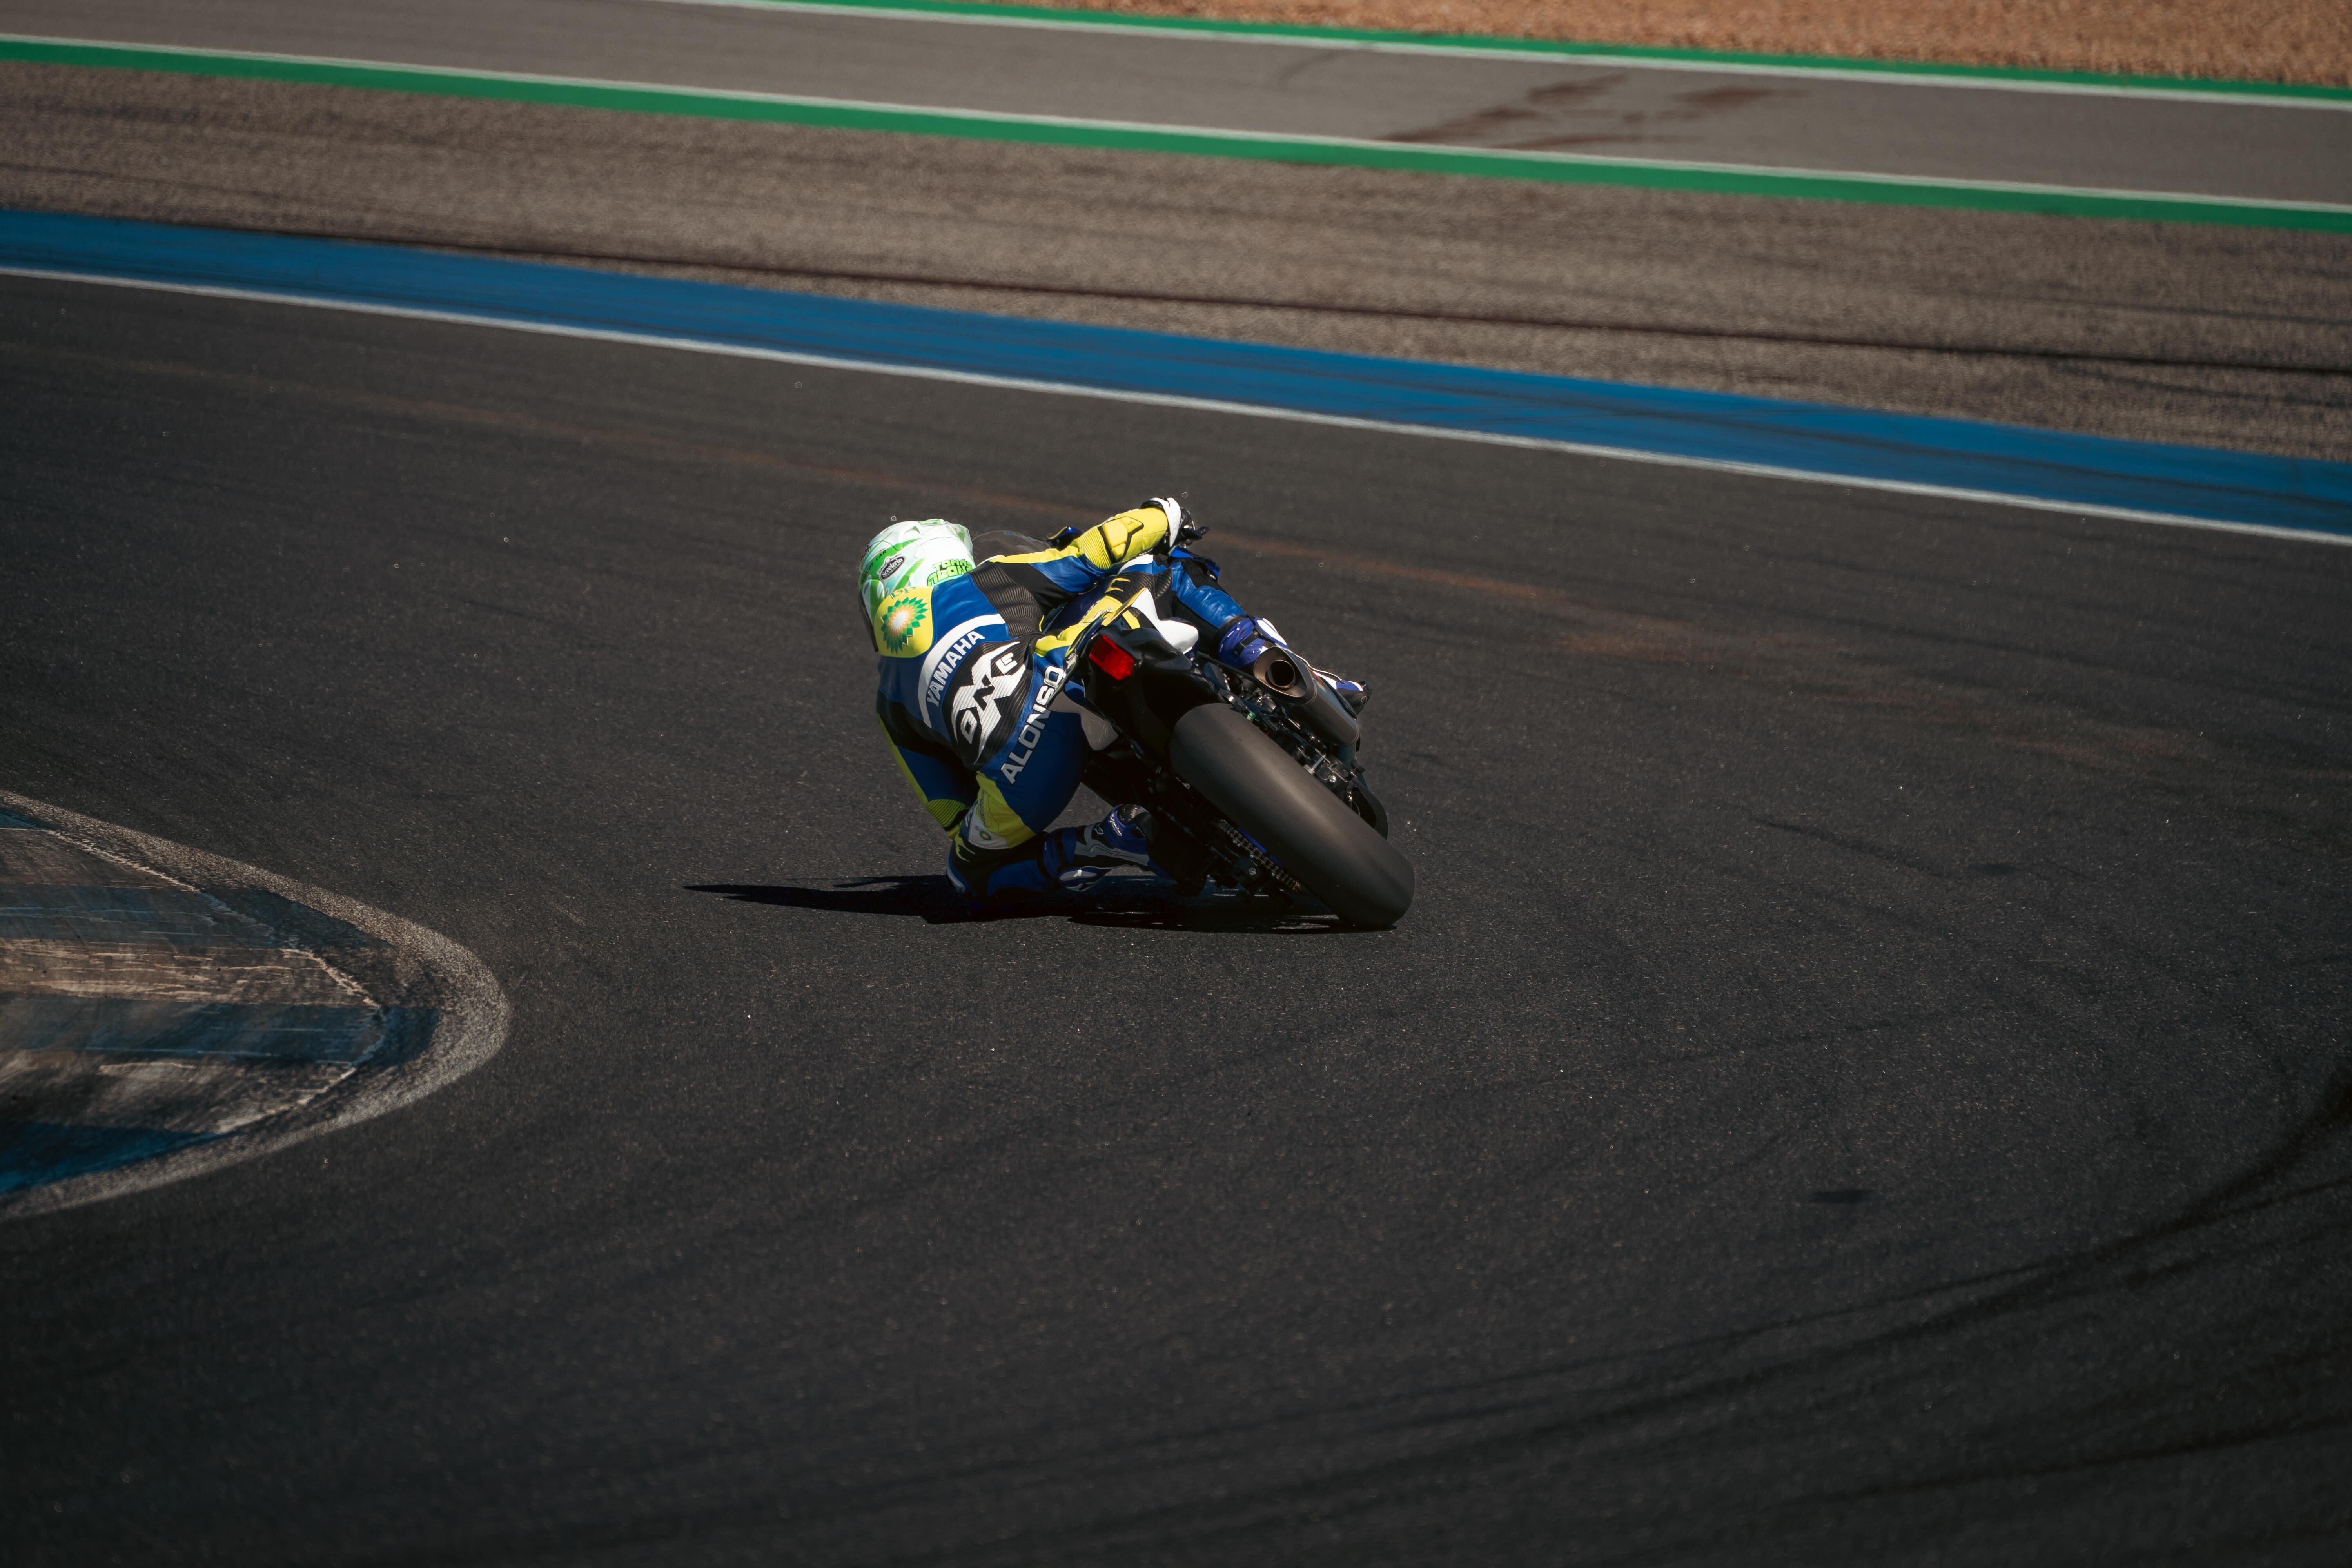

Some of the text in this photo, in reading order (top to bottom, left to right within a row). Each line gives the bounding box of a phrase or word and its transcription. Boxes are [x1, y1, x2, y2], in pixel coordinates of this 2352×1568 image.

[876, 550, 886, 561] CAR
[927, 630, 985, 706] YAMAHA
[1000, 665, 1064, 784] ALONSO
